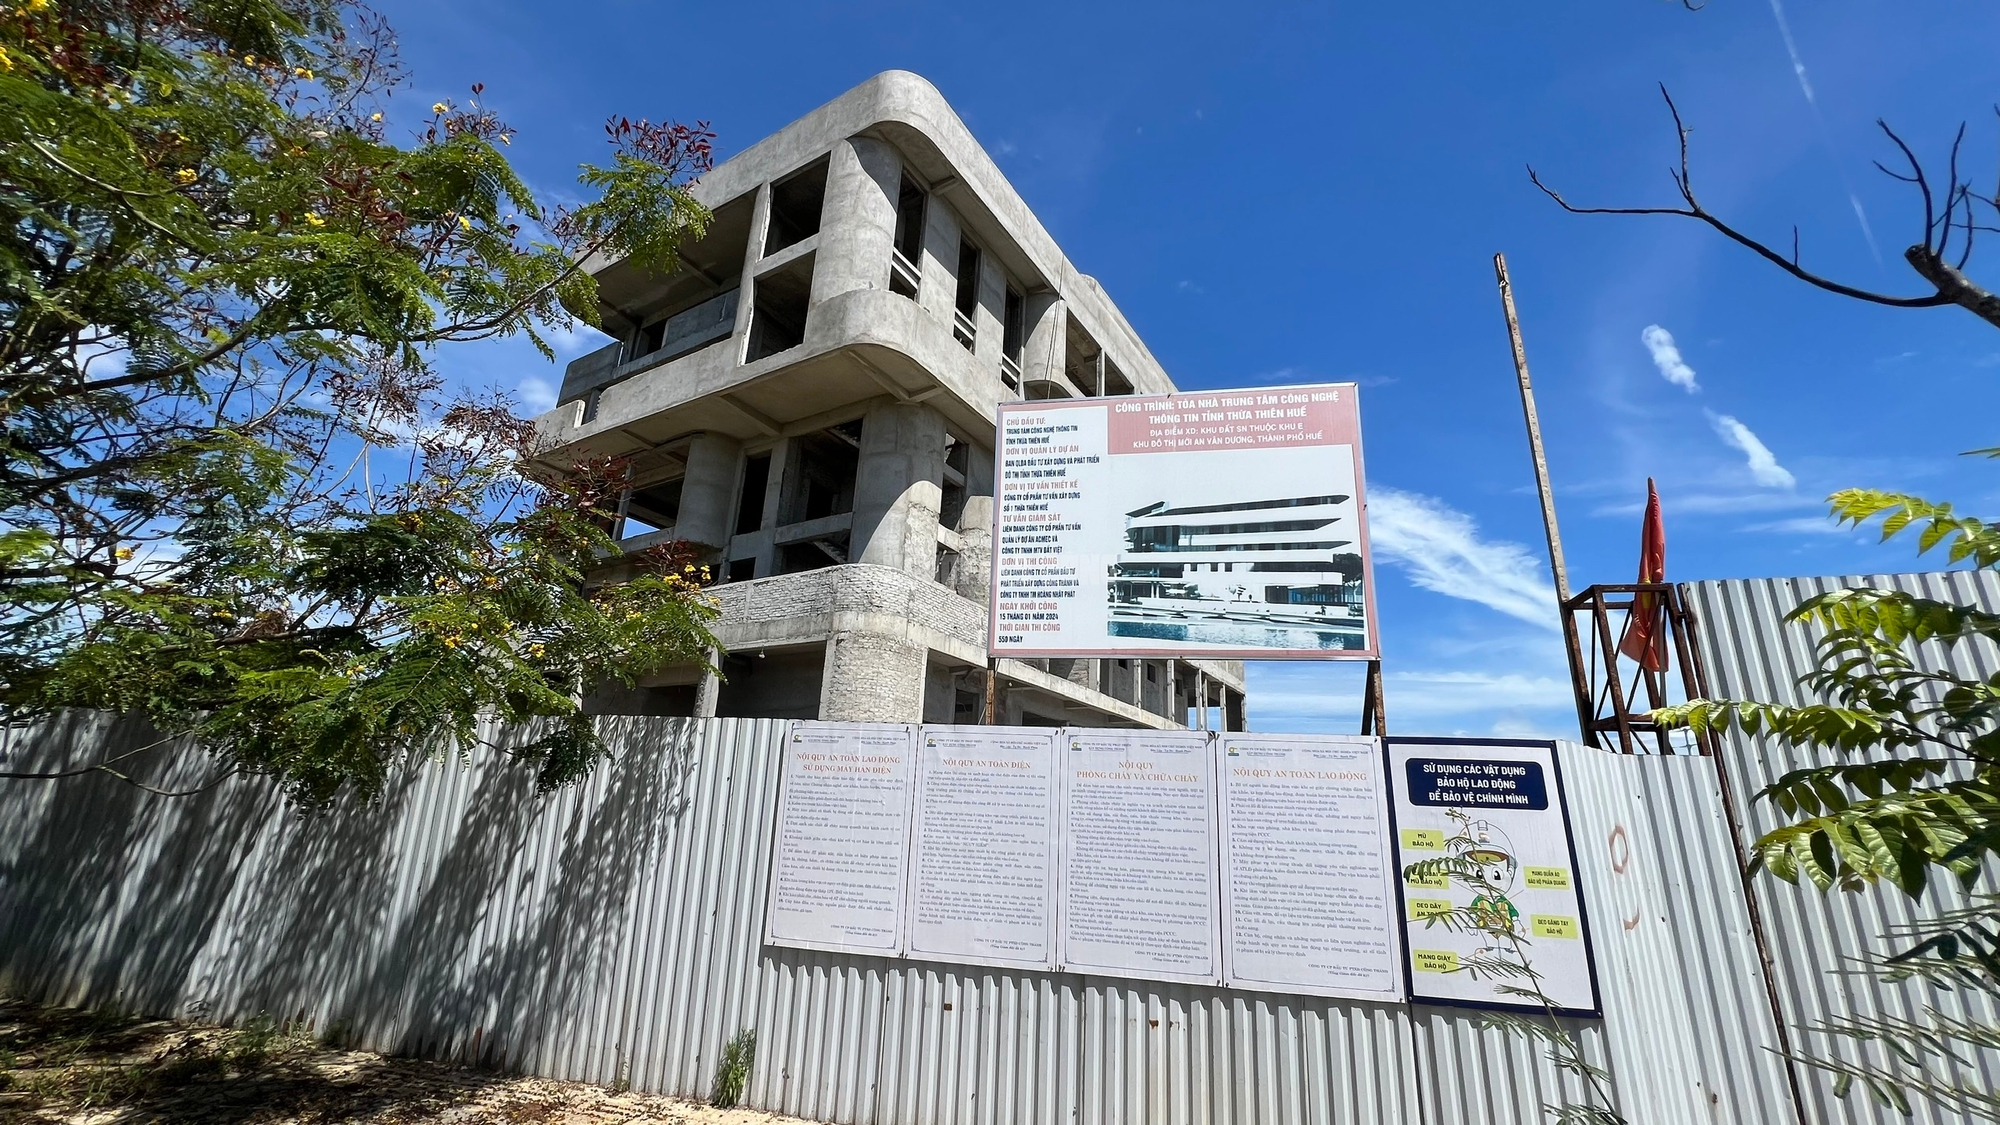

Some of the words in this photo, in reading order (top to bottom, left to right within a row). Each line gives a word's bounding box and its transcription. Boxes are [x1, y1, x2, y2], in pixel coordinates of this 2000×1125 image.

[1115, 402, 1141, 413] CÔNG
[1144, 400, 1174, 411] TRÌNH:
[1198, 397, 1218, 408] NHÀ
[1222, 397, 1254, 407] TRUNG
[1256, 394, 1278, 405] TÂM
[1281, 393, 1309, 404] CÔNG
[1311, 390, 1339, 403] NGHỆ
[1149, 414, 1180, 424] THÔNG
[1183, 414, 1199, 422] TIN
[1202, 410, 1224, 421] TỈNH
[1227, 410, 1253, 420] THỪA
[1255, 407, 1284, 419] THIÊN
[1287, 405, 1307, 417] HUẾ
[1006, 417, 1019, 426] CHỦ
[1021, 416, 1034, 425] ĐẦU
[1150, 429, 1163, 437] ĐỊA
[1165, 426, 1183, 435] ĐIỂM
[1201, 426, 1217, 434] KHU
[1219, 423, 1235, 433] ĐẤT
[1249, 423, 1276, 432] THUỘC
[1151, 438, 1162, 447] ĐÔ
[1164, 439, 1176, 448] THỊ
[1178, 437, 1192, 446] MỚI
[1207, 436, 1223, 445] VÂN
[1225, 435, 1255, 445] DƯƠNG,
[1257, 434, 1284, 443] THÀNH
[1287, 431, 1304, 441] PHỐ
[1305, 430, 1323, 440] HUẾ
[1021, 448, 1028, 456] VỊ
[1029, 445, 1047, 455] QUẢN
[1049, 445, 1057, 454] LÝ
[1058, 446, 1068, 454] DỰ
[1005, 483, 1017, 491] ĐƠN
[1019, 483, 1026, 491] VỊ
[1027, 482, 1036, 490] TƯ
[1036, 481, 1049, 489] VẤN
[1051, 481, 1068, 489] THIẾT
[1070, 479, 1078, 488] KẾ
[1013, 513, 1026, 522] VẤN
[1028, 513, 1046, 522] GIÁM
[1048, 513, 1061, 521] SÁT
[1018, 558, 1024, 567] VỊ
[1039, 557, 1057, 565] CÔNG
[1000, 601, 1018, 610] NGÀY
[1020, 600, 1036, 610] KHỞI
[1038, 601, 1057, 610] CÔNG
[1007, 612, 1024, 620] THÁNG
[1032, 612, 1045, 620] NĂM
[1000, 623, 1013, 631] THỜI
[1015, 623, 1030, 631] GIAN
[1031, 623, 1041, 631] THI
[1043, 622, 1061, 631] CÔNG
[1009, 634, 1023, 643] NGÀY
[797, 751, 810, 761] NỘI
[811, 754, 826, 762] QUY
[840, 753, 860, 762] TOÀN
[878, 755, 900, 764] ĐỘNG
[943, 757, 957, 767] NỘI
[958, 760, 974, 768] QUY
[989, 759, 1009, 768] TOÀN
[1011, 759, 1031, 770] ĐIỆN
[803, 762, 813, 771] SỬ
[855, 765, 871, 773] HÀN
[872, 766, 892, 774] ĐIỆN
[1119, 760, 1134, 770] NỘI
[1136, 762, 1154, 770] QUY
[1423, 762, 1436, 773] SỬ
[1437, 764, 1462, 775] DỤNG
[1463, 764, 1481, 774] CÁC
[1483, 764, 1499, 777] VẬT
[1501, 766, 1526, 777] DỤNG
[1076, 770, 1107, 779] PHÒNG
[1108, 771, 1132, 780] CHÁY
[1134, 772, 1146, 781] VÀ
[1147, 772, 1172, 781] CHỮA
[1174, 773, 1199, 782] CHÁY
[1233, 767, 1250, 778] NỘI
[1252, 769, 1272, 778] QUY
[1274, 770, 1287, 778] AN
[1289, 768, 1316, 779] TOÀN
[1339, 770, 1367, 782] ĐỘNG
[1437, 776, 1455, 787] BẢO
[1457, 777, 1469, 790] HỘ
[1471, 779, 1489, 788] LAO
[1491, 778, 1516, 791] ĐỘNG
[1429, 788, 1441, 801] ĐỂ
[1443, 790, 1461, 802] BẢO
[1462, 791, 1475, 804] VỆ
[1476, 792, 1504, 804] CHÍNH
[1506, 793, 1529, 804] MÌNH
